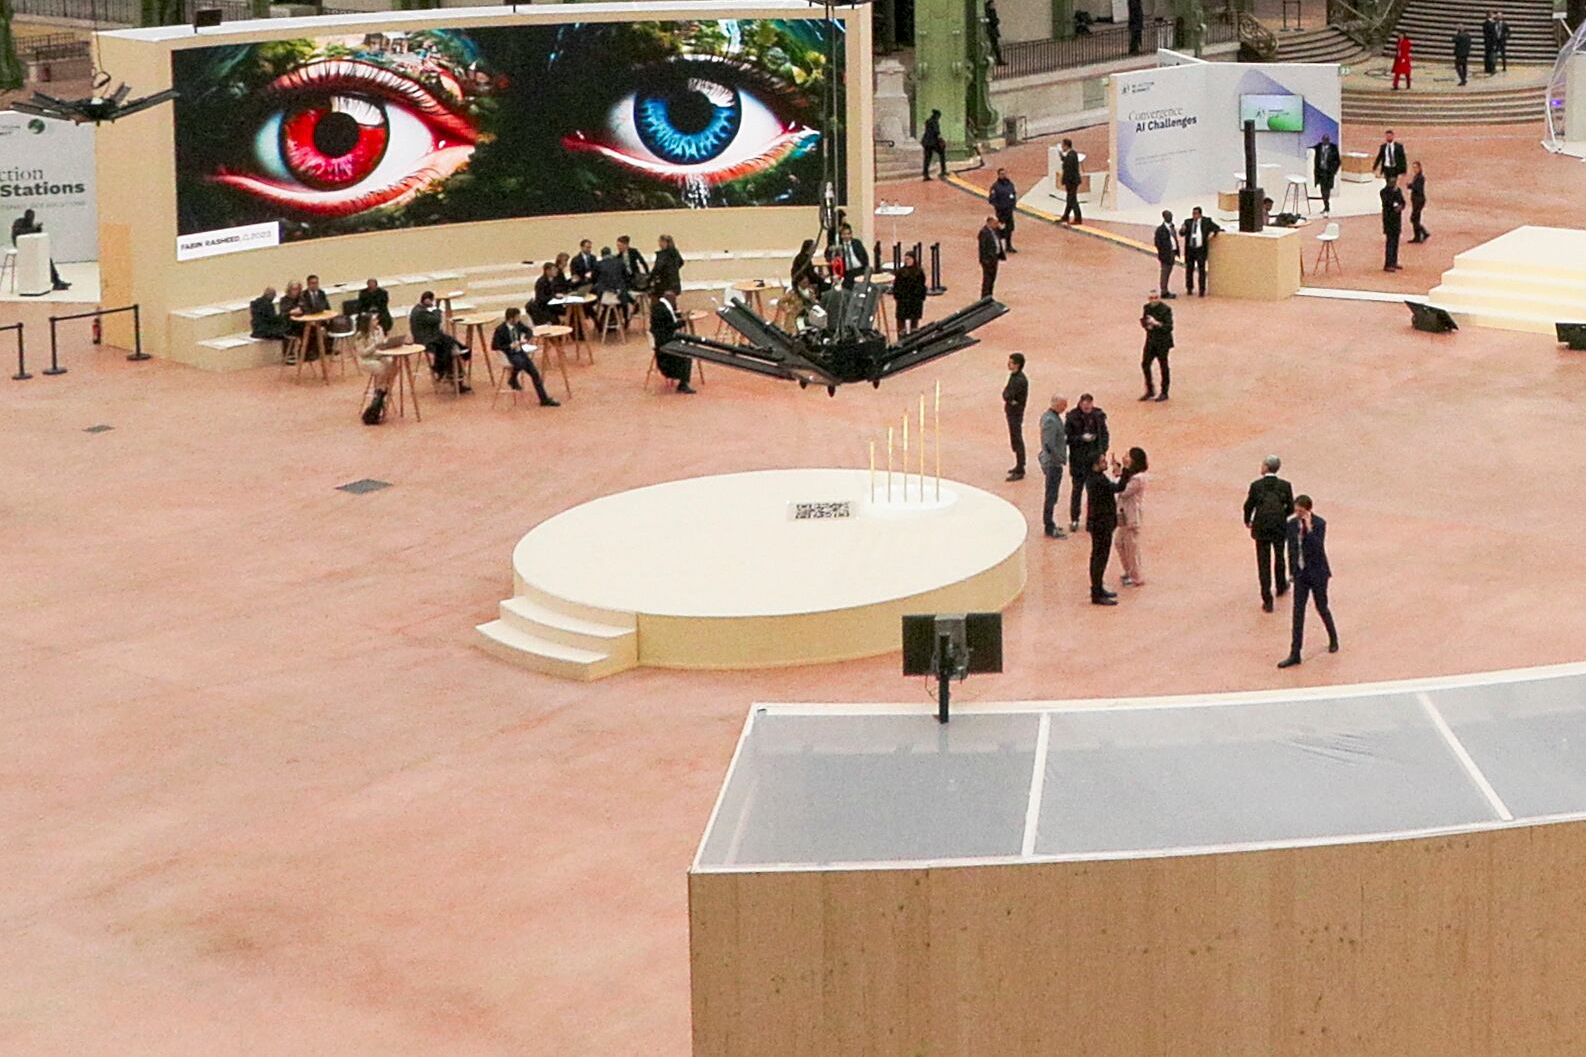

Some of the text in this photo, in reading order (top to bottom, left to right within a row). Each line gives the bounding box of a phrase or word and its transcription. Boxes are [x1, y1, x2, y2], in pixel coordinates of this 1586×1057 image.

[1128, 107, 1183, 121] Convergence
[1136, 116, 1198, 133] AI Challenges
[0, 181, 86, 198] Stations
